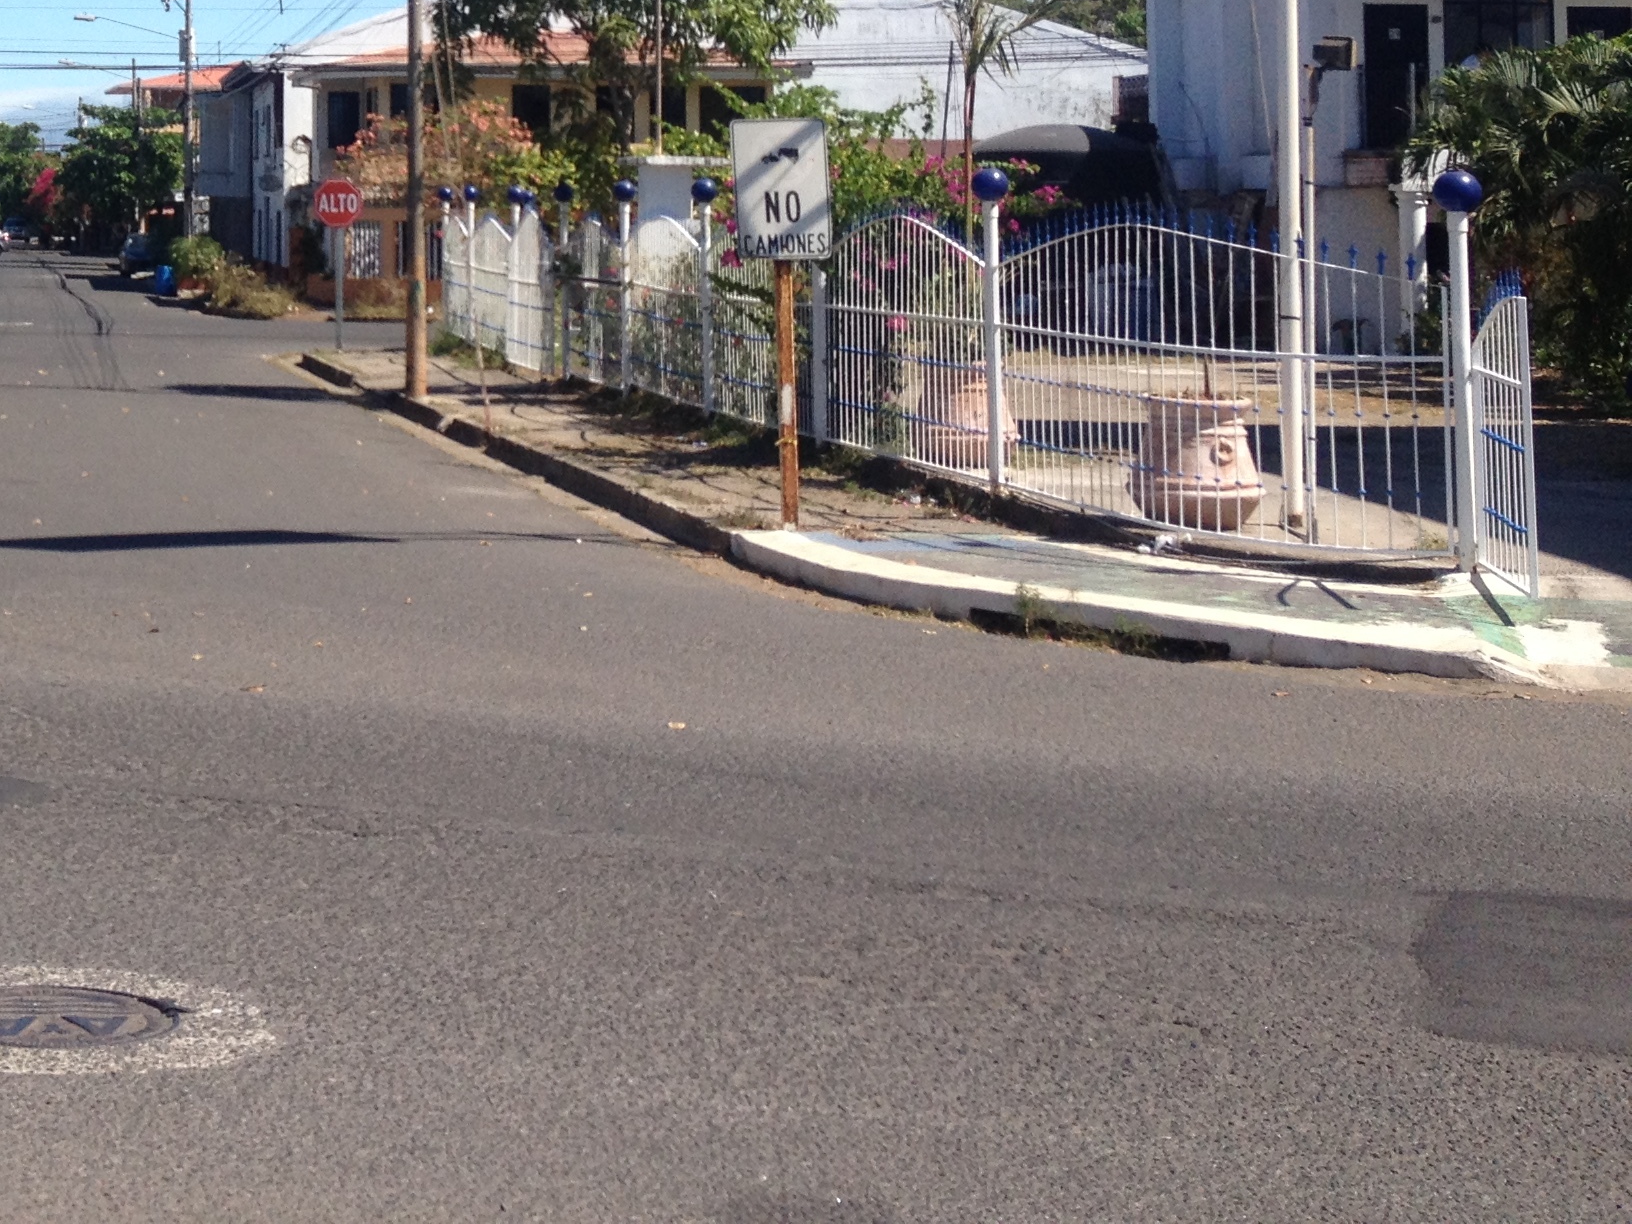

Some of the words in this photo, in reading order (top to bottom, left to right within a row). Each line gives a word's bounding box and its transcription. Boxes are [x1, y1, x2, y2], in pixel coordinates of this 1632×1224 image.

[318, 193, 358, 214] ALTO
[764, 190, 801, 223] NO
[743, 233, 826, 254] CAMIONES
